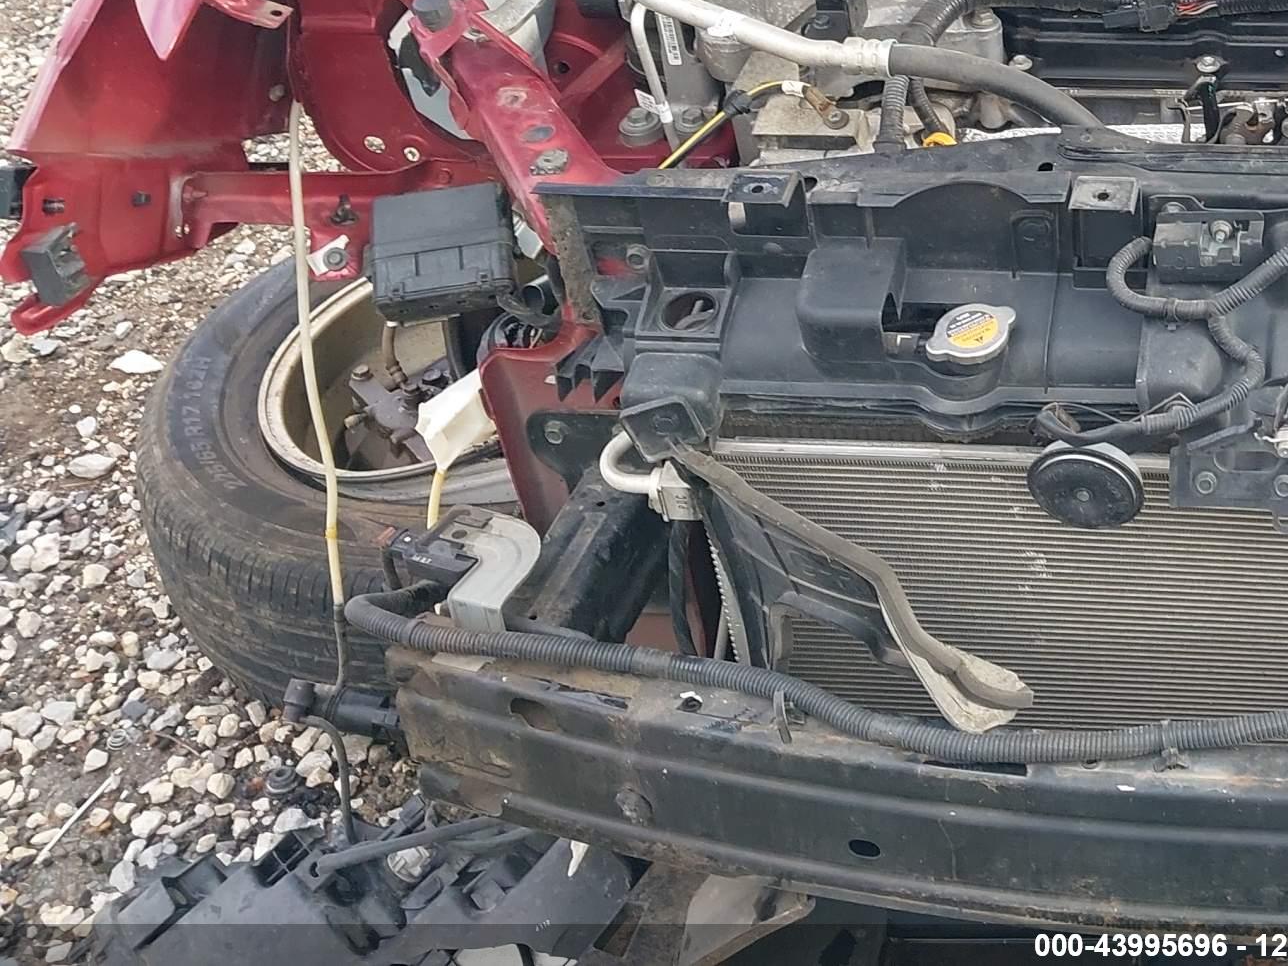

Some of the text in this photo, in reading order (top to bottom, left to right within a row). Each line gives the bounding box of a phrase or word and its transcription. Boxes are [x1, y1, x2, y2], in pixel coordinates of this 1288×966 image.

[181, 356, 249, 491] 225/65 R17 102H
